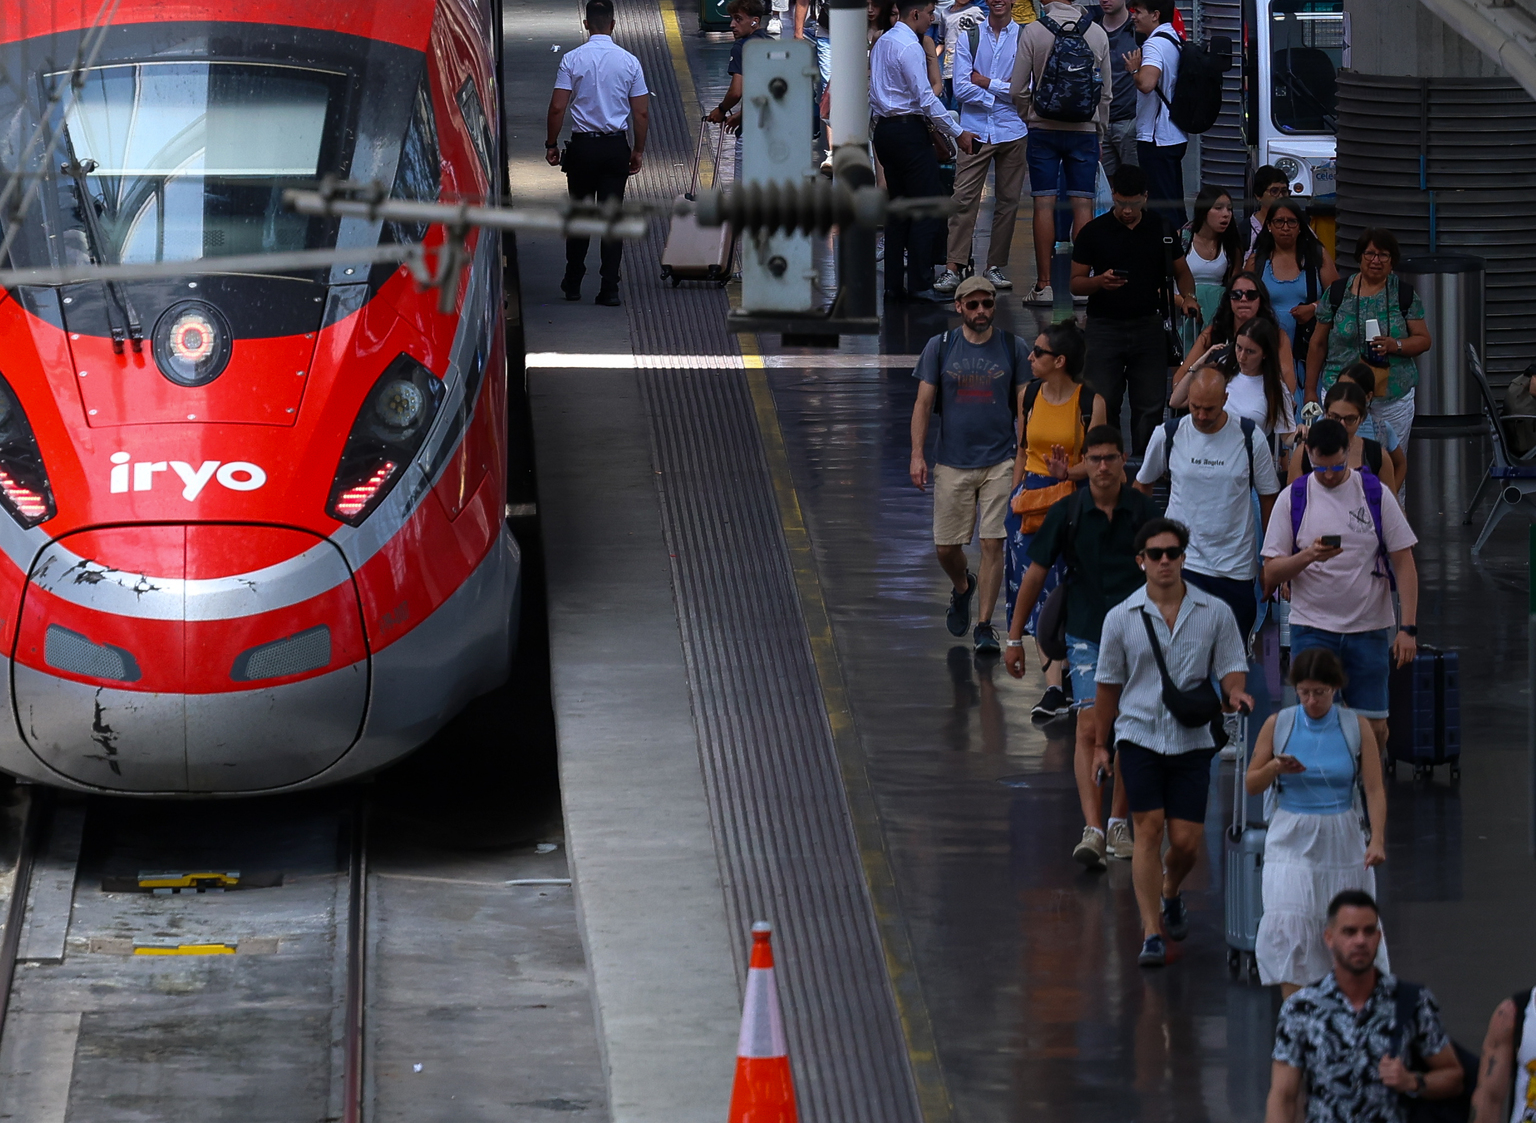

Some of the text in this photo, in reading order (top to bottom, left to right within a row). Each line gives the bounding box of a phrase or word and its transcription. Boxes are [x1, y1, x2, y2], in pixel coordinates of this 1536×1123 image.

[109, 451, 267, 503] iryo
[1190, 457, 1225, 467] Los Angeles
